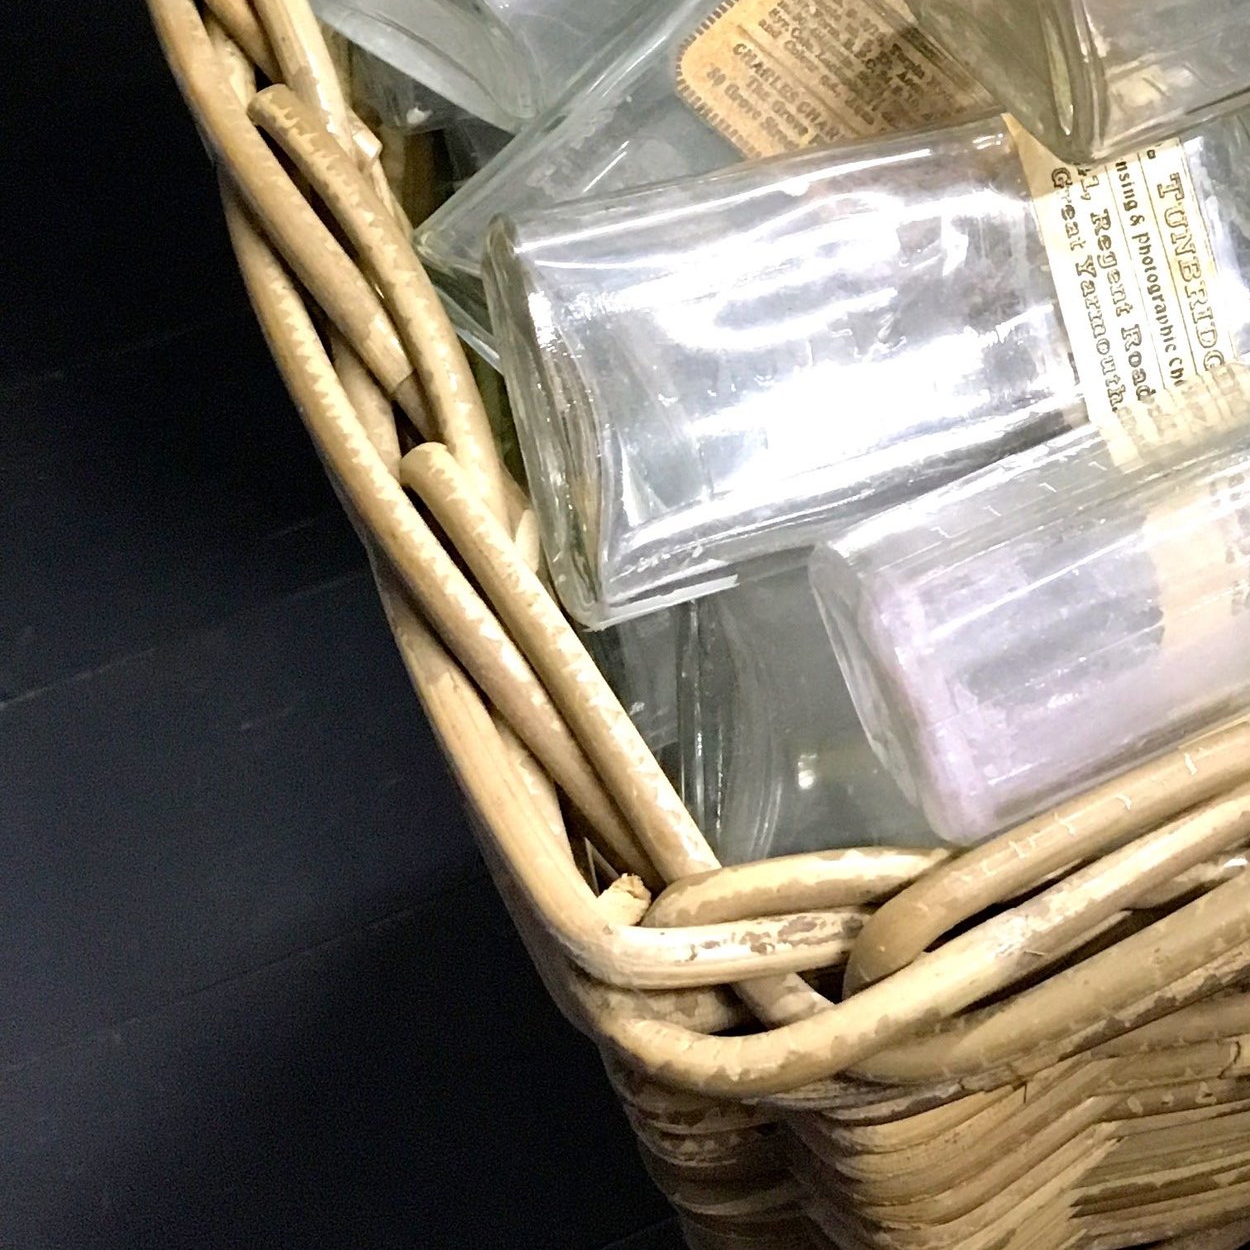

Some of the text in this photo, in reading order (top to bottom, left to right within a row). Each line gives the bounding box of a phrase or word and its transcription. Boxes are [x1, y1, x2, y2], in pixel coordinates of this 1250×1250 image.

[730, 41, 801, 103] CHARLES
[794, 99, 845, 144] CHAR
[1051, 167, 1126, 413] Great Yarmouth.
[1090, 208, 1133, 318] Regent
[1120, 323, 1156, 401] Road
